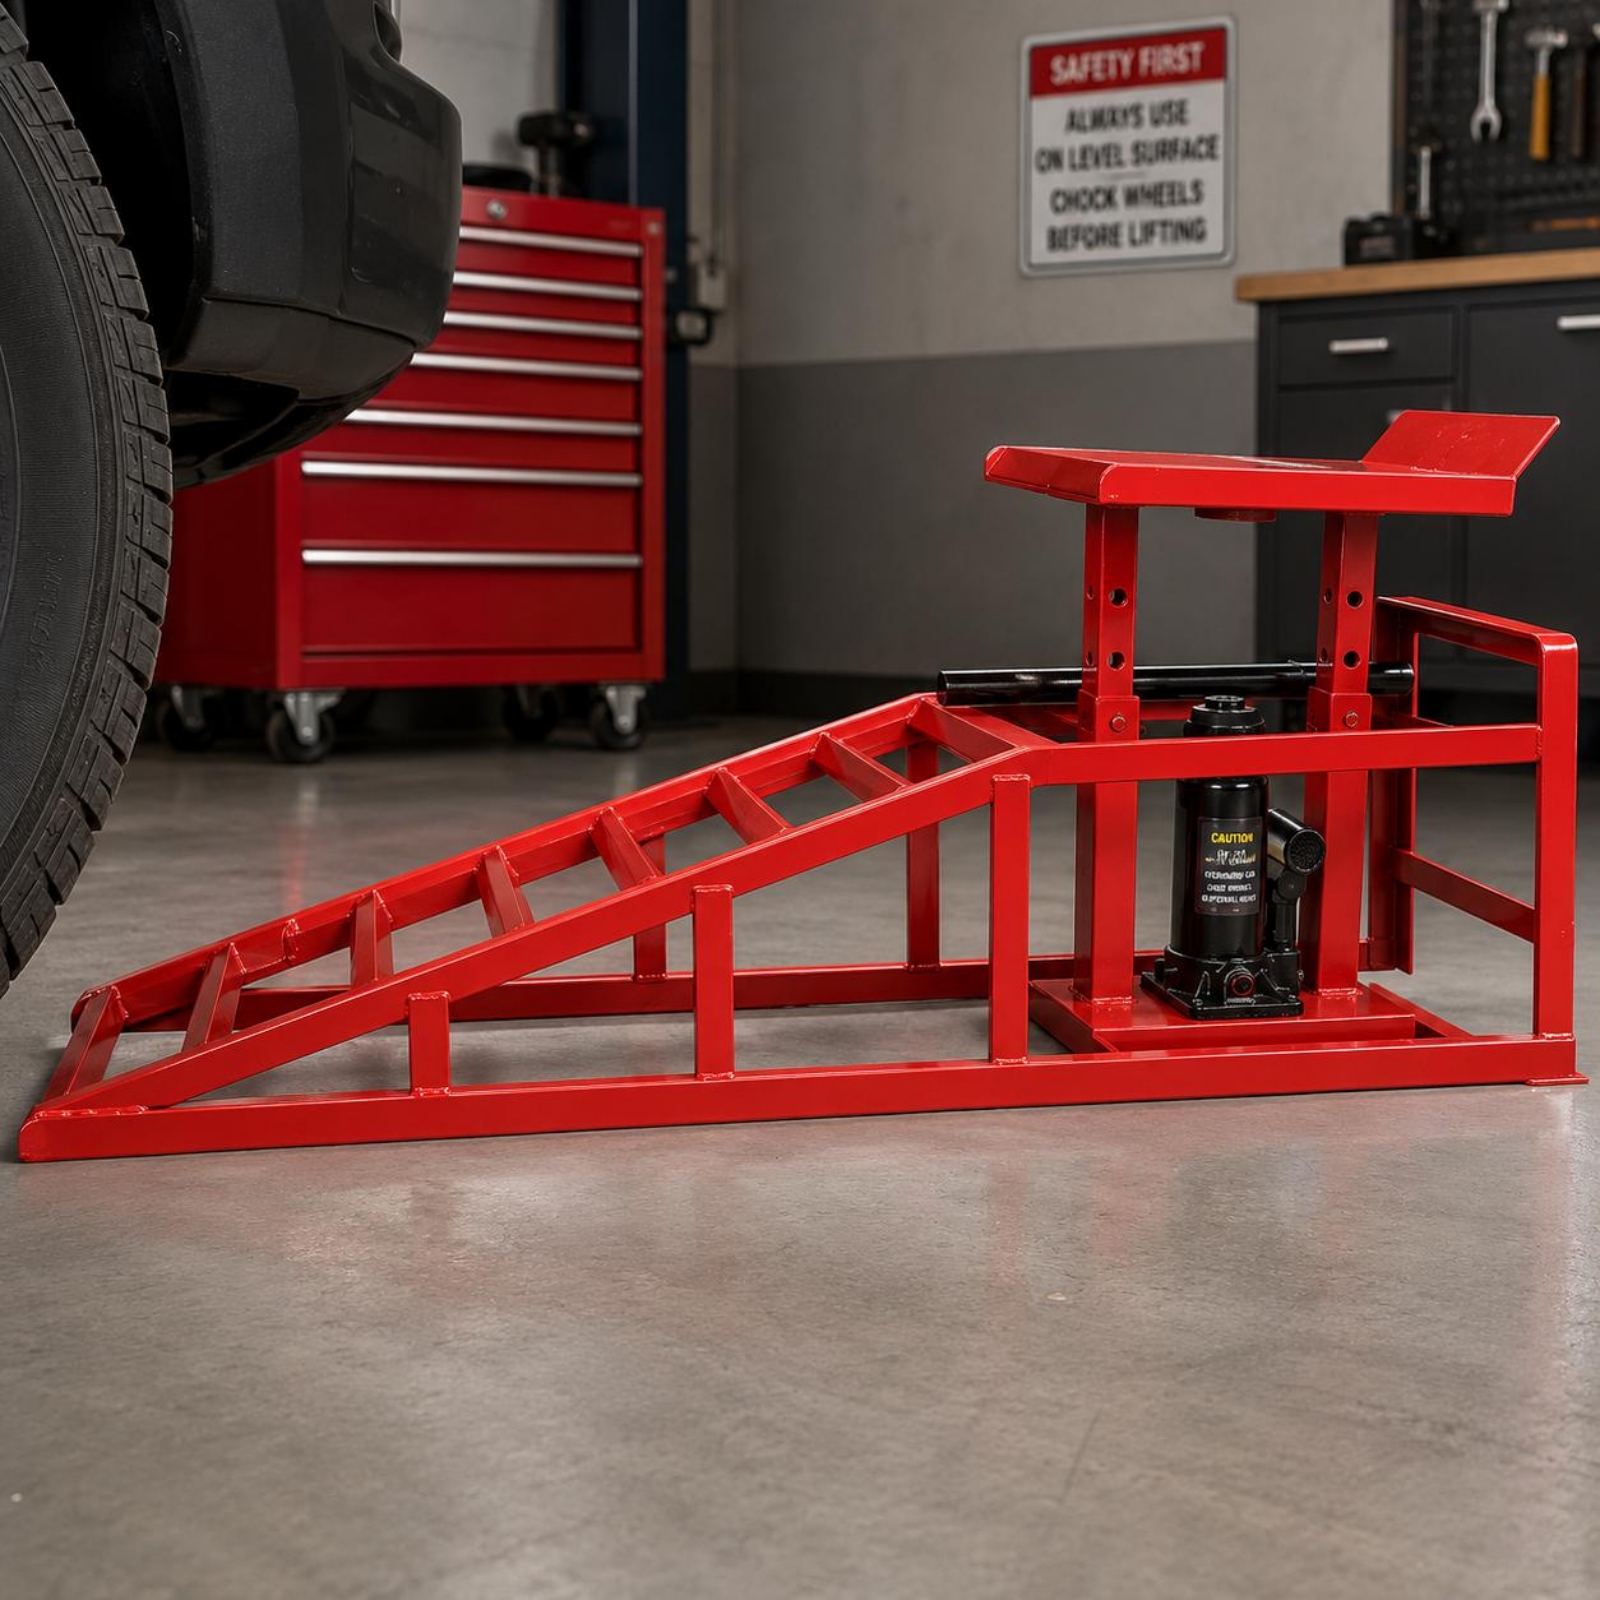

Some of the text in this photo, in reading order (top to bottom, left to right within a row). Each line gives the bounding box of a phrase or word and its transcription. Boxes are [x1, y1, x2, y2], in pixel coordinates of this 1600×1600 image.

[1050, 41, 1205, 85] SAFETY FIRST
[1065, 100, 1189, 134] ALWAYS USE
[1035, 135, 1219, 174] ON LEVEL SURFACE
[1051, 179, 1204, 215] CHOCK WHEELS
[1047, 217, 1207, 252] BEFORE LIFTING
[1211, 832, 1254, 843] CAUTION
